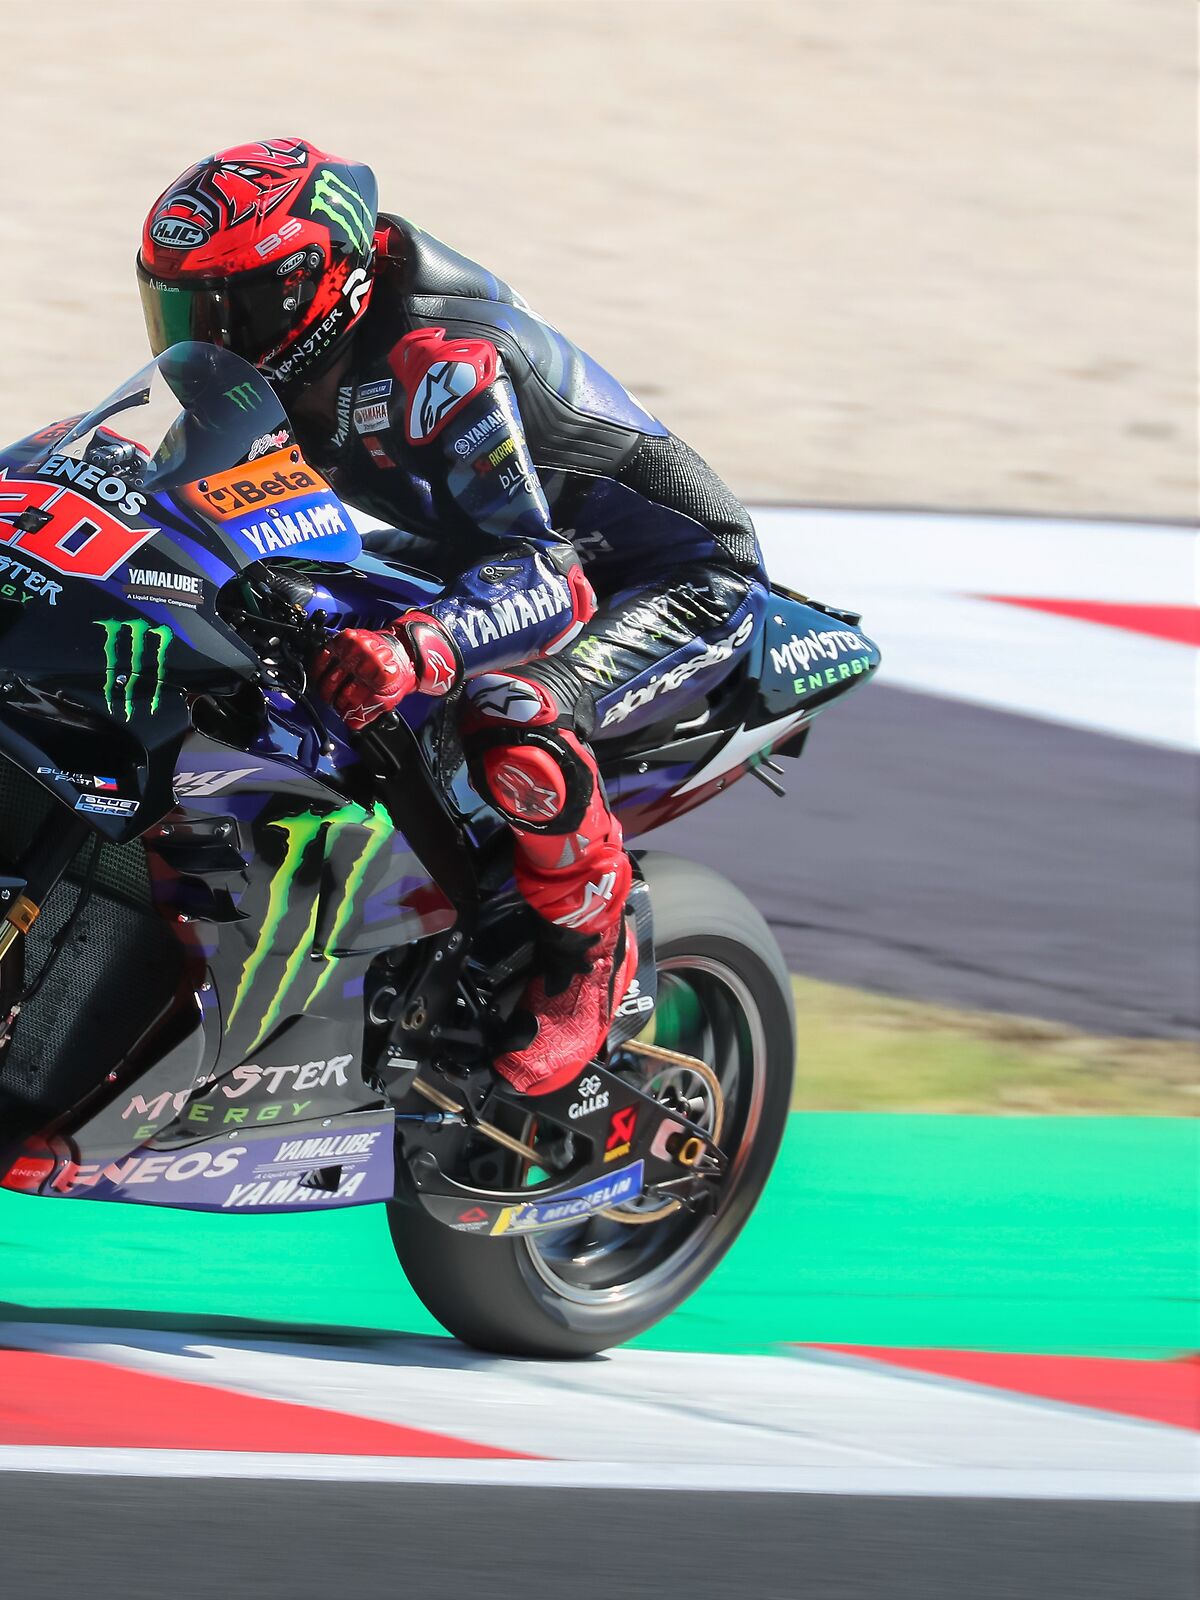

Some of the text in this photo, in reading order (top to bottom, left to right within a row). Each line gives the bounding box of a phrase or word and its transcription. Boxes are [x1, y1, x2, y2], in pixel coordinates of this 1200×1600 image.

[154, 223, 201, 243] HJC
[255, 218, 302, 257] BS
[281, 254, 304, 272] HJC
[331, 386, 353, 448] YAMAHA
[464, 408, 506, 444] YAMAH
[37, 455, 147, 516] ENEOS
[231, 471, 316, 504] Beta
[240, 504, 347, 554] YAMAHA
[129, 569, 198, 594] YAMALUBE
[168, 599, 197, 610] Component
[456, 579, 571, 648] YAMAHA
[793, 656, 870, 694] ENERGY
[82, 804, 129, 815] CORE
[85, 796, 132, 808] BLUE
[133, 1101, 311, 1140] EERGY
[273, 1132, 381, 1162] YAMALUBE
[51, 1147, 248, 1193] ENEOS
[542, 1177, 632, 1222] MICHELIN
